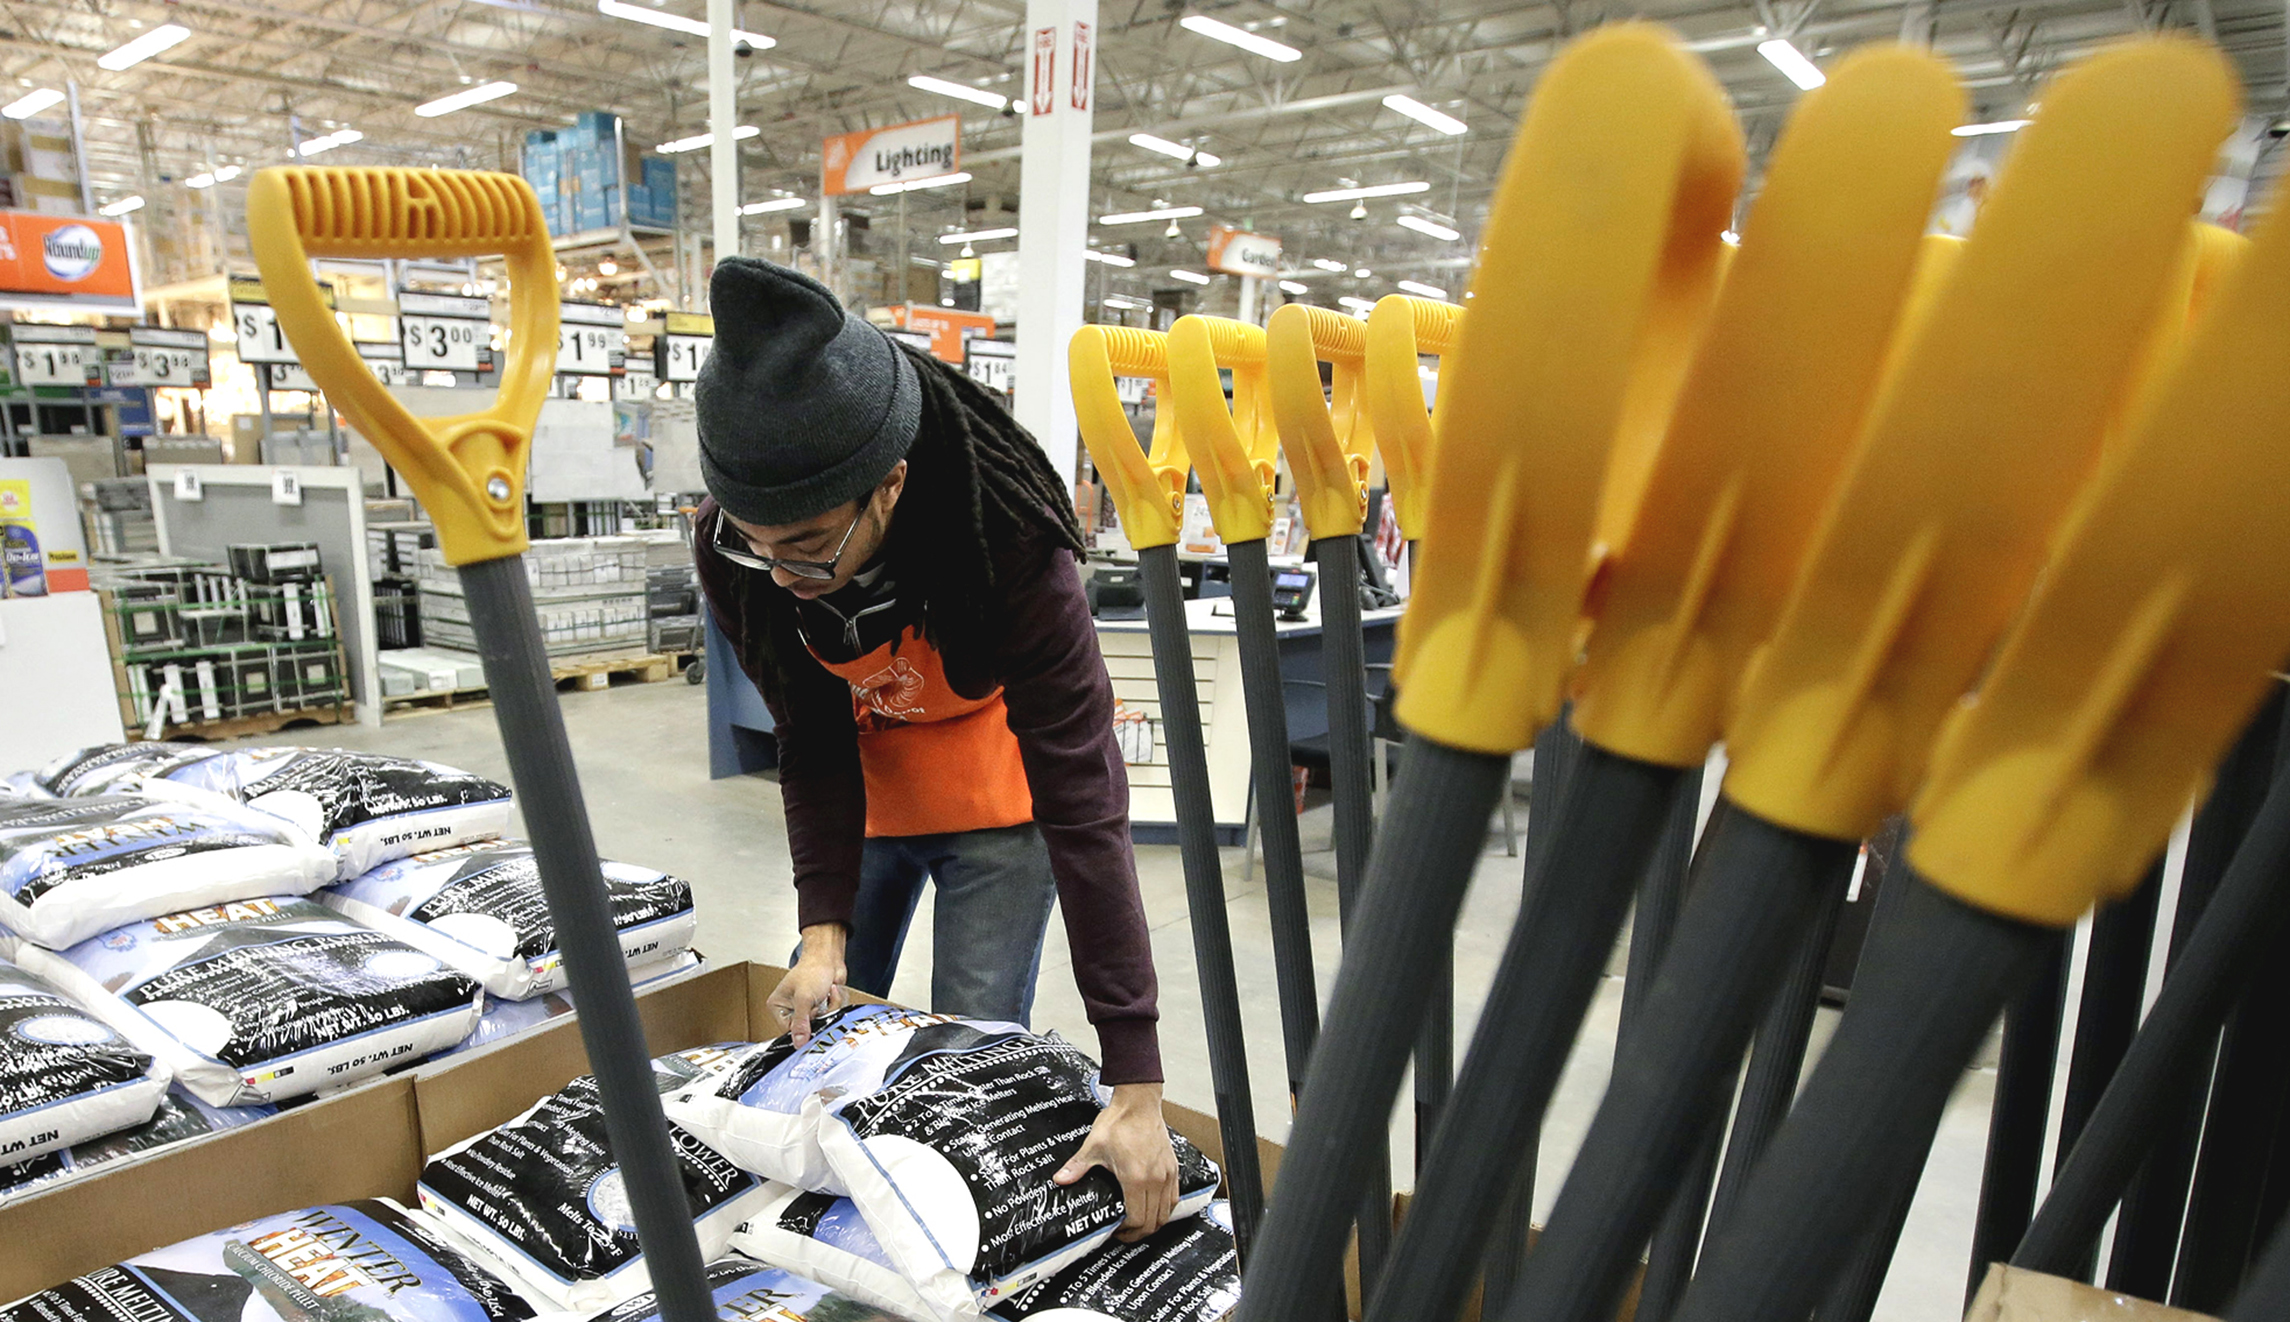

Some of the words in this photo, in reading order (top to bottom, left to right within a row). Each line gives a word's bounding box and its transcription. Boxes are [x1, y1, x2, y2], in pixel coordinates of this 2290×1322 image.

[875, 141, 953, 176] Lighting
[380, 835, 399, 846] LBS.
[401, 832, 413, 842] 50
[414, 829, 432, 840] WT.
[433, 826, 451, 837] NET
[156, 898, 278, 934] HEAT
[625, 946, 642, 959] WT.
[642, 941, 659, 951] NET
[138, 965, 201, 999] PURE
[352, 1055, 366, 1067] 50
[369, 1047, 389, 1063] WT.
[391, 1043, 413, 1055] NET
[327, 1061, 350, 1075] LBS.
[856, 1075, 922, 1122] PURE
[921, 1039, 1026, 1075] MELTING
[995, 1075, 1016, 1089] Than
[1017, 1070, 1036, 1084] Rock
[556, 1092, 574, 1107] Times
[573, 1100, 594, 1114] Faster
[924, 1126, 933, 1136] &
[972, 1098, 986, 1112] Ice
[986, 1087, 1018, 1107] Melters
[977, 1106, 1027, 1134] Generating
[1026, 1096, 1057, 1118] Melting
[1056, 1093, 1076, 1107] Heat
[29, 1130, 60, 1146] NET
[487, 1136, 500, 1149] Than
[500, 1142, 514, 1156] Rock
[512, 1146, 526, 1160] Salt
[588, 1142, 606, 1158] Heat
[962, 1137, 992, 1158] Upon
[991, 1124, 1026, 1146] Contact
[1003, 1152, 1021, 1166] For
[1020, 1140, 1049, 1160] Plants
[1048, 1137, 1056, 1146] &
[1055, 1124, 1093, 1142] Vegetatio
[474, 1152, 498, 1172] Powdery
[494, 1161, 516, 1181] Residue
[508, 1130, 519, 1142] For
[517, 1135, 536, 1151] Plants
[534, 1144, 541, 1154] &
[540, 1148, 576, 1178] Vegetation
[455, 1164, 480, 1184] Effective
[476, 1178, 486, 1188] Ice
[579, 1165, 609, 1198] MINIMUM
[984, 1174, 1012, 1192] Than
[1011, 1163, 1036, 1180] Rock
[1035, 1152, 1056, 1167] Salt
[992, 1204, 1008, 1217] No
[1008, 1186, 1048, 1209] Powdery
[466, 1194, 482, 1210] NET
[482, 1204, 498, 1222] WT.
[498, 1216, 510, 1230] 50
[508, 1222, 525, 1242] LBS.
[557, 1202, 584, 1226] Melts
[582, 1218, 596, 1235] To
[990, 1229, 1014, 1249] Most
[1014, 1213, 1052, 1235] Effective
[1052, 1204, 1068, 1218] Ice
[1064, 1218, 1090, 1238] NET
[1091, 1206, 1115, 1224] WT.
[1116, 1201, 1126, 1213] 5
[249, 1226, 367, 1298] HEAT
[295, 1209, 423, 1295] WINTER
[1202, 1248, 1236, 1277] Vegetation
[226, 1243, 258, 1275] CALCIUM
[254, 1258, 294, 1296] CHLORIDE
[289, 1285, 321, 1311] PELLET
[1062, 1290, 1072, 1299] 2
[1070, 1280, 1082, 1293] To
[1080, 1274, 1088, 1282] 5
[1085, 1256, 1110, 1278] Times
[1086, 1266, 1117, 1297] Blended
[1114, 1258, 1128, 1270] Ice
[1110, 1286, 1134, 1309] Starts
[1129, 1258, 1170, 1291] Generating
[1162, 1240, 1190, 1264] Melting
[1186, 1230, 1204, 1245] Heat
[1198, 1270, 1208, 1280] &
[86, 1266, 129, 1289] URE
[110, 1283, 175, 1322] MELTIN
[478, 1280, 492, 1298] the
[487, 1297, 504, 1318] USA
[1126, 1290, 1152, 1312] Upon
[1148, 1268, 1176, 1292] Contact
[1170, 1291, 1184, 1306] For
[1179, 1274, 1203, 1297] Plants
[1184, 1293, 1205, 1312] Rock
[1198, 1284, 1216, 1299] Salt
[35, 1301, 57, 1321] Blended
[50, 1291, 59, 1302] To
[58, 1298, 78, 1318] Times
[1151, 1301, 1173, 1322] Safer
